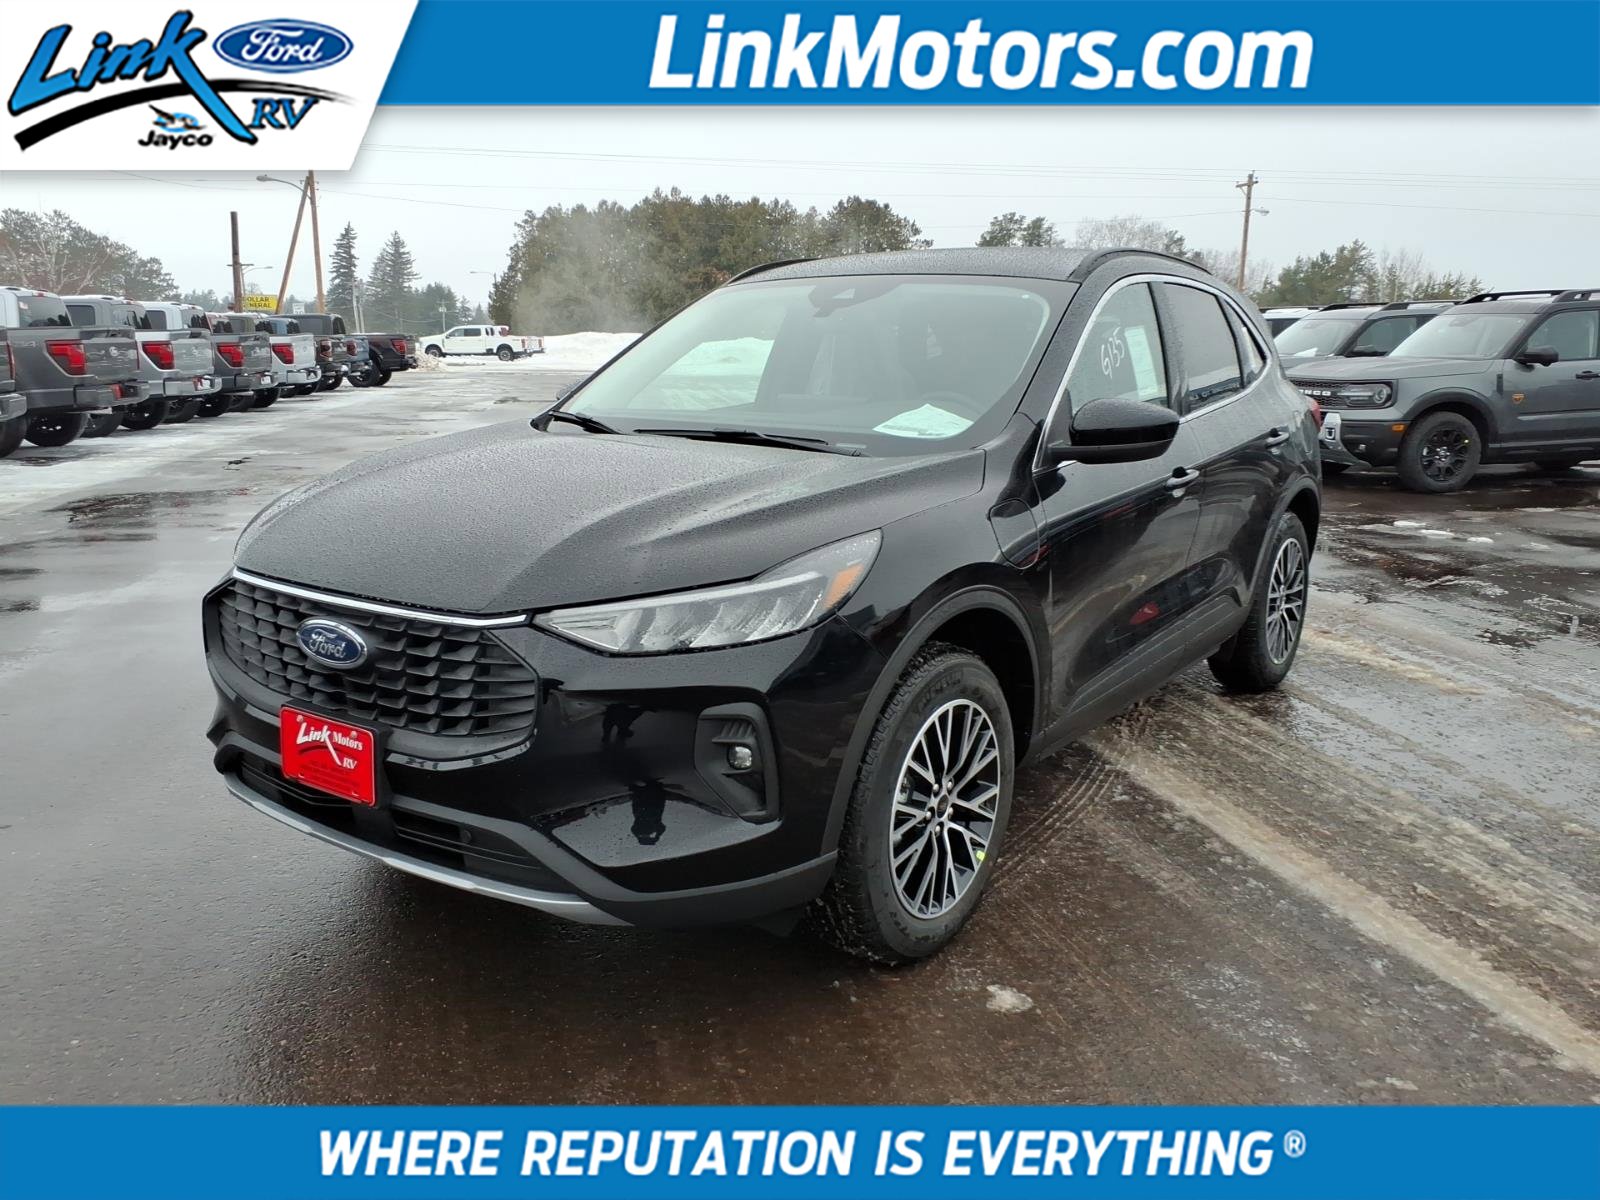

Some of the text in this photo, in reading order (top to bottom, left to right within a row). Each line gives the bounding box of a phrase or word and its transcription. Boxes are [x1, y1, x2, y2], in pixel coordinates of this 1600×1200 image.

[308, 627, 347, 660] Ford
[296, 722, 363, 766] Link Motors
[342, 757, 358, 769] RV
